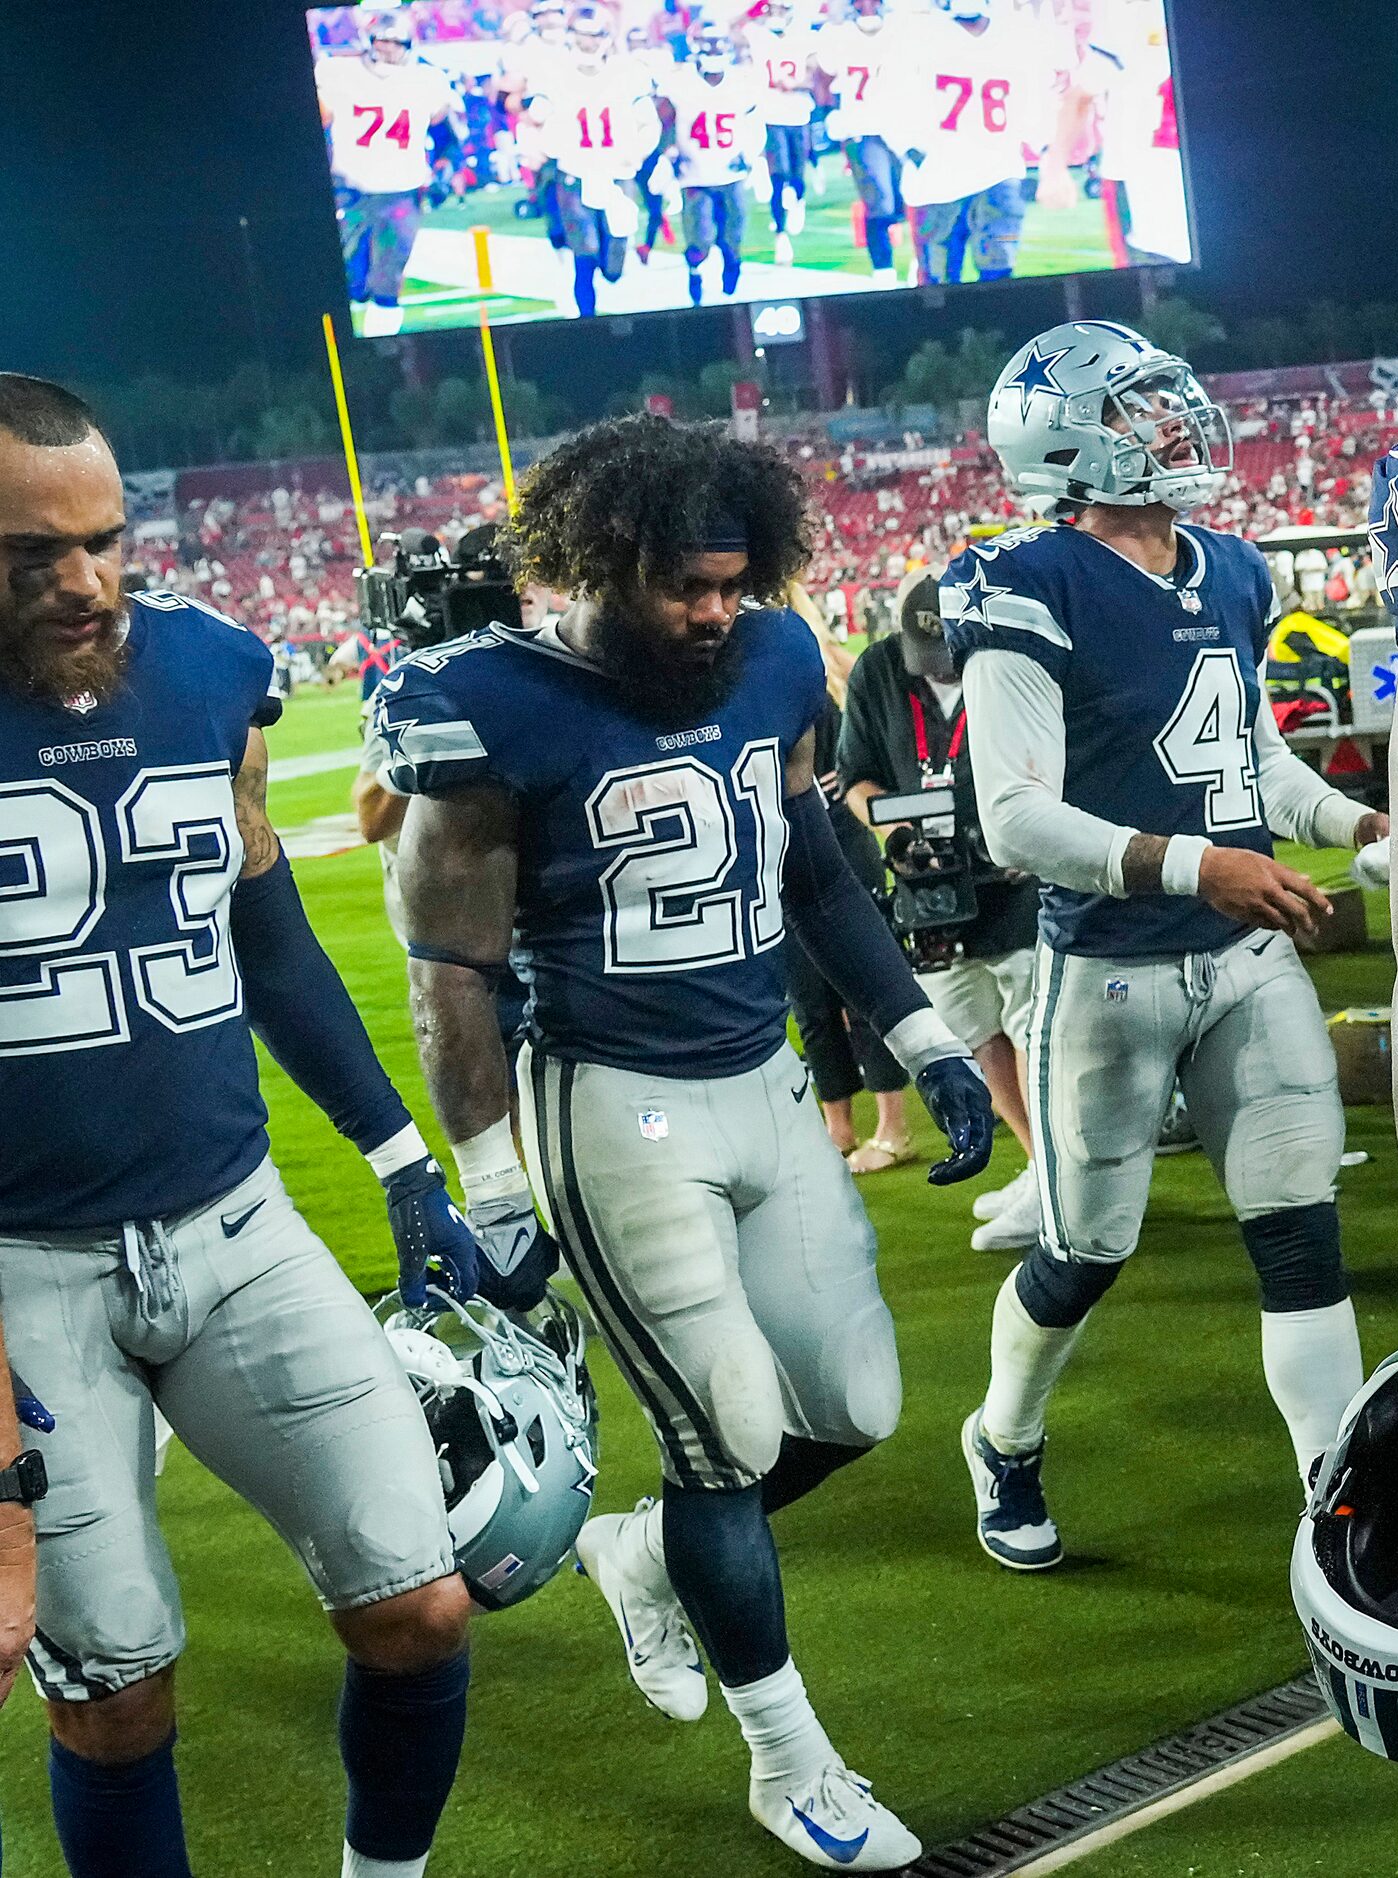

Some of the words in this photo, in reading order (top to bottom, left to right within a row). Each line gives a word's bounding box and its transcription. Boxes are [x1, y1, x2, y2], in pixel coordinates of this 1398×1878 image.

[935, 74, 1010, 132] 78
[353, 105, 410, 150] 74
[576, 107, 614, 149] 11
[690, 112, 736, 149] 45
[38, 737, 138, 767] COWBOYS
[655, 724, 722, 752] COWBOYS
[1152, 647, 1263, 833] 4
[584, 737, 791, 974] 21
[0, 760, 246, 1058] 23
